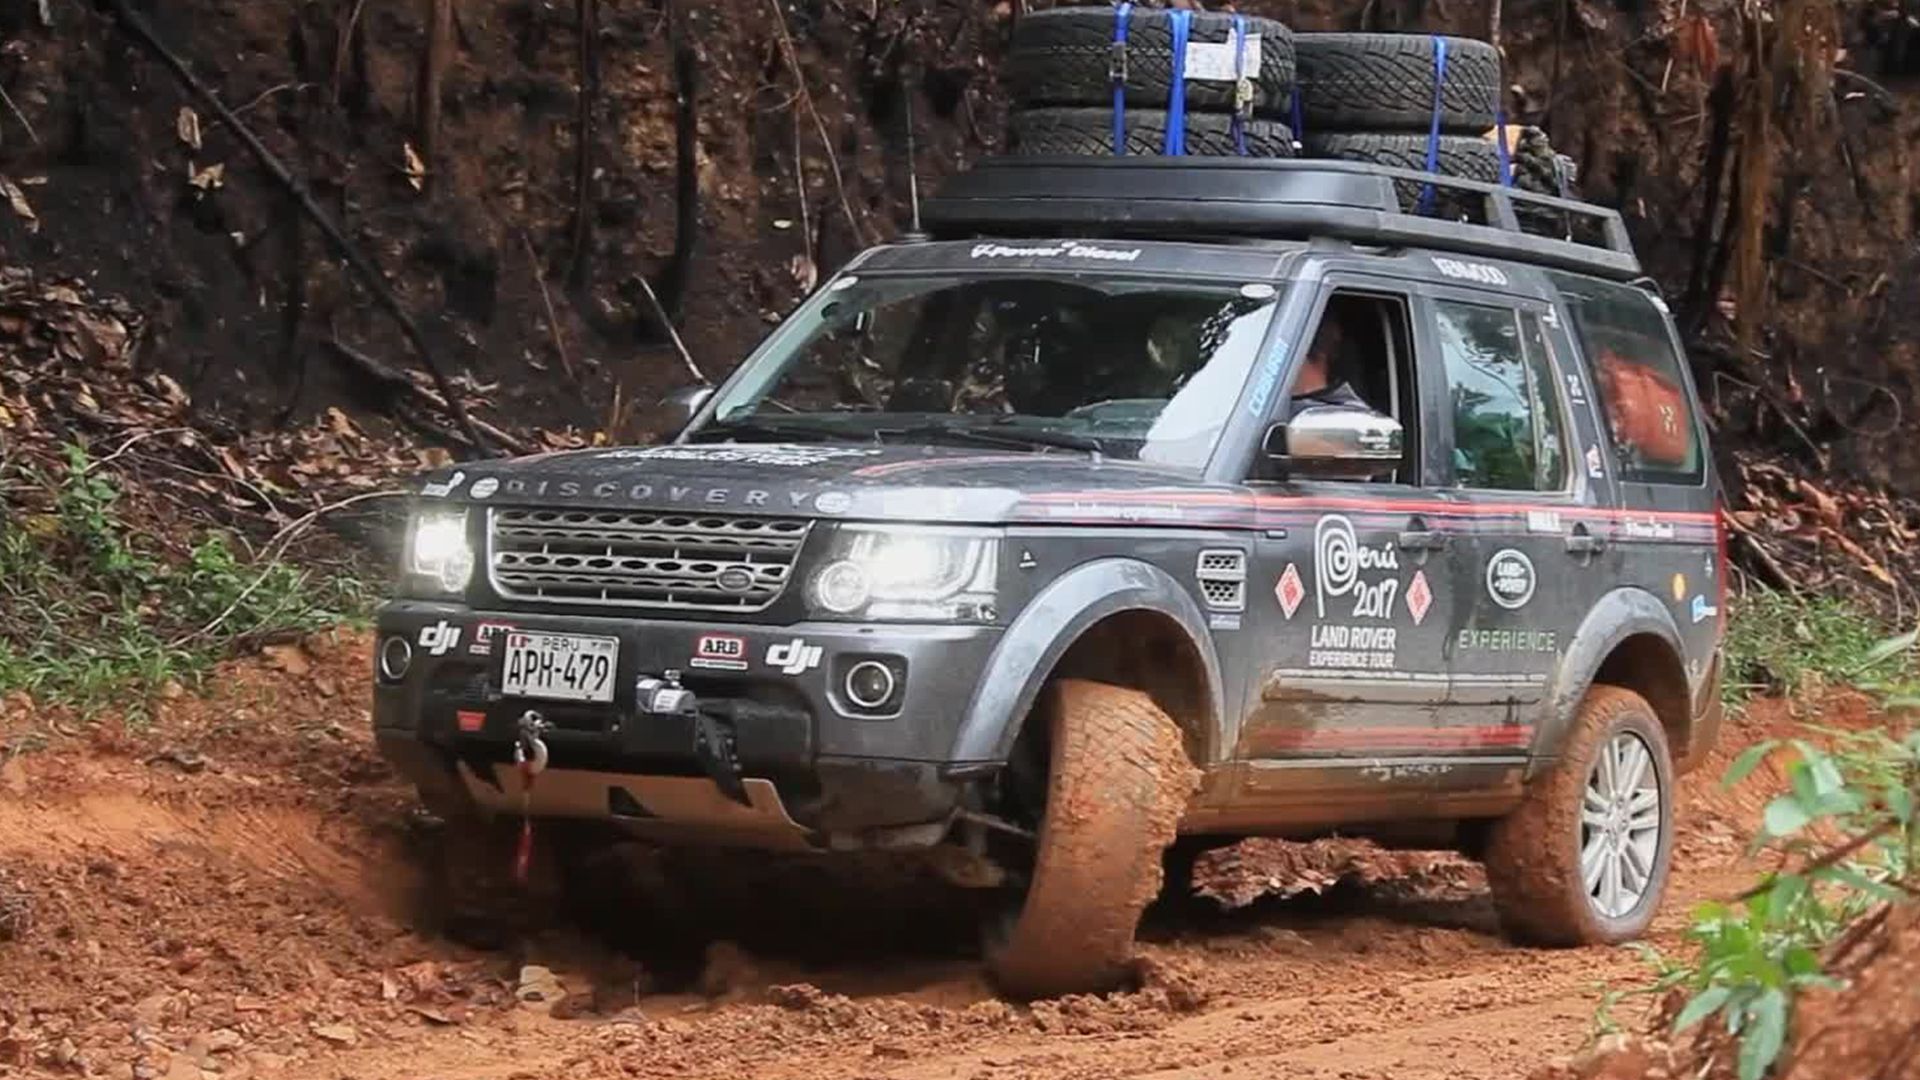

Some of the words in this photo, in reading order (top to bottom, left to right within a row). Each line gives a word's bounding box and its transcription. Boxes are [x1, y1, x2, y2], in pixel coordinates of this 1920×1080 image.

[506, 479, 810, 509] DISCOVERY
[1352, 579, 1399, 619] 2017
[541, 637, 581, 652] PERU
[702, 639, 739, 655] ARB
[1311, 625, 1349, 648] LAND
[1350, 627, 1396, 650] ROVER
[1459, 629, 1556, 652] EXPERIENCE
[507, 649, 610, 692] APH-479
[1309, 650, 1369, 667] EXPERIENCE
[1369, 652, 1396, 668] TOUR
